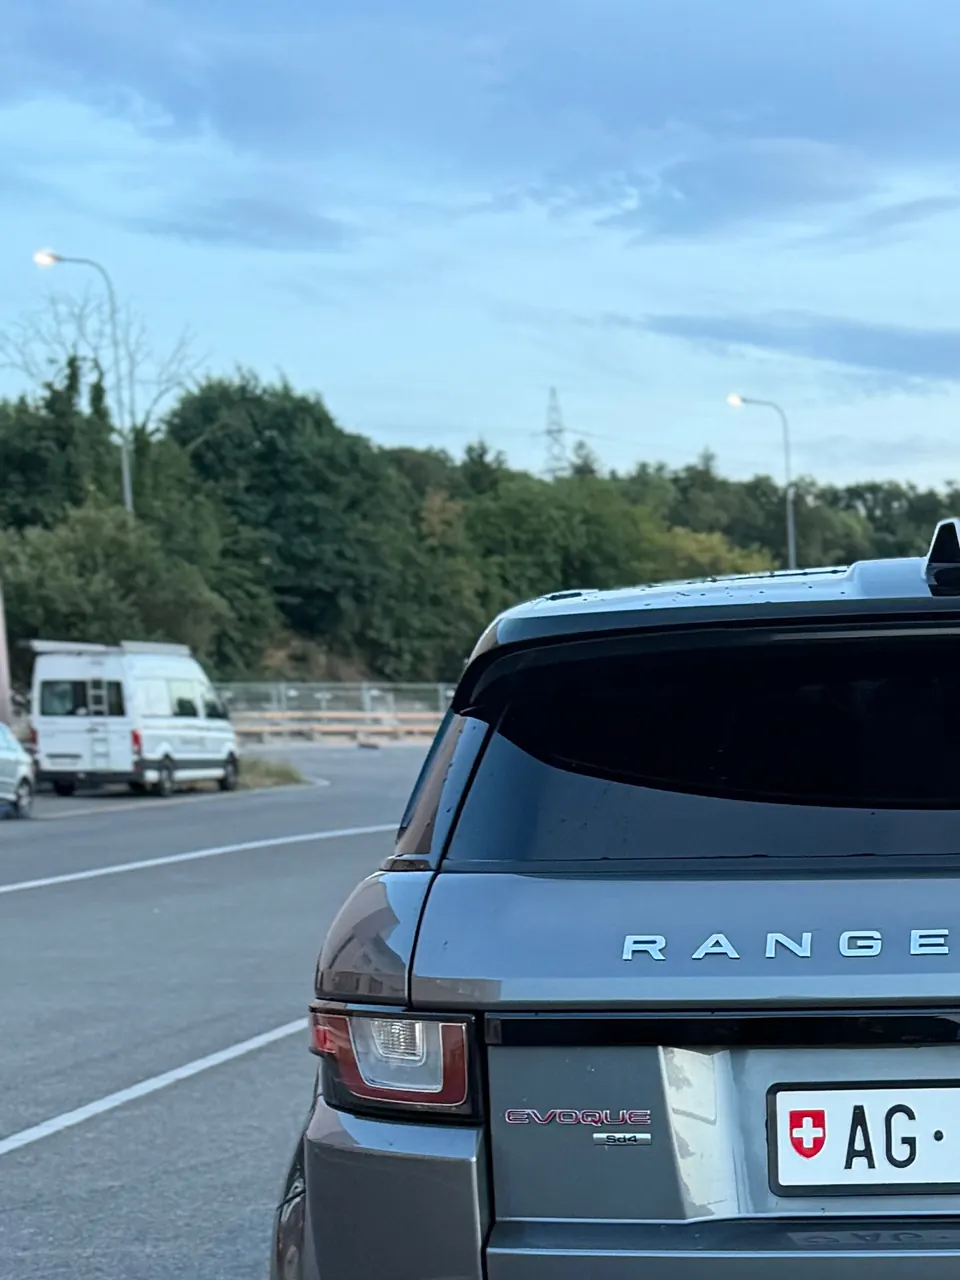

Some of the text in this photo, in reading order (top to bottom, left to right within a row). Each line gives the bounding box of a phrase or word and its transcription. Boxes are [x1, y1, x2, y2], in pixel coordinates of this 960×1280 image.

[622, 929, 949, 961] RANGE
[505, 1109, 651, 1126] EVOQUE
[605, 1134, 639, 1144] Sd4
